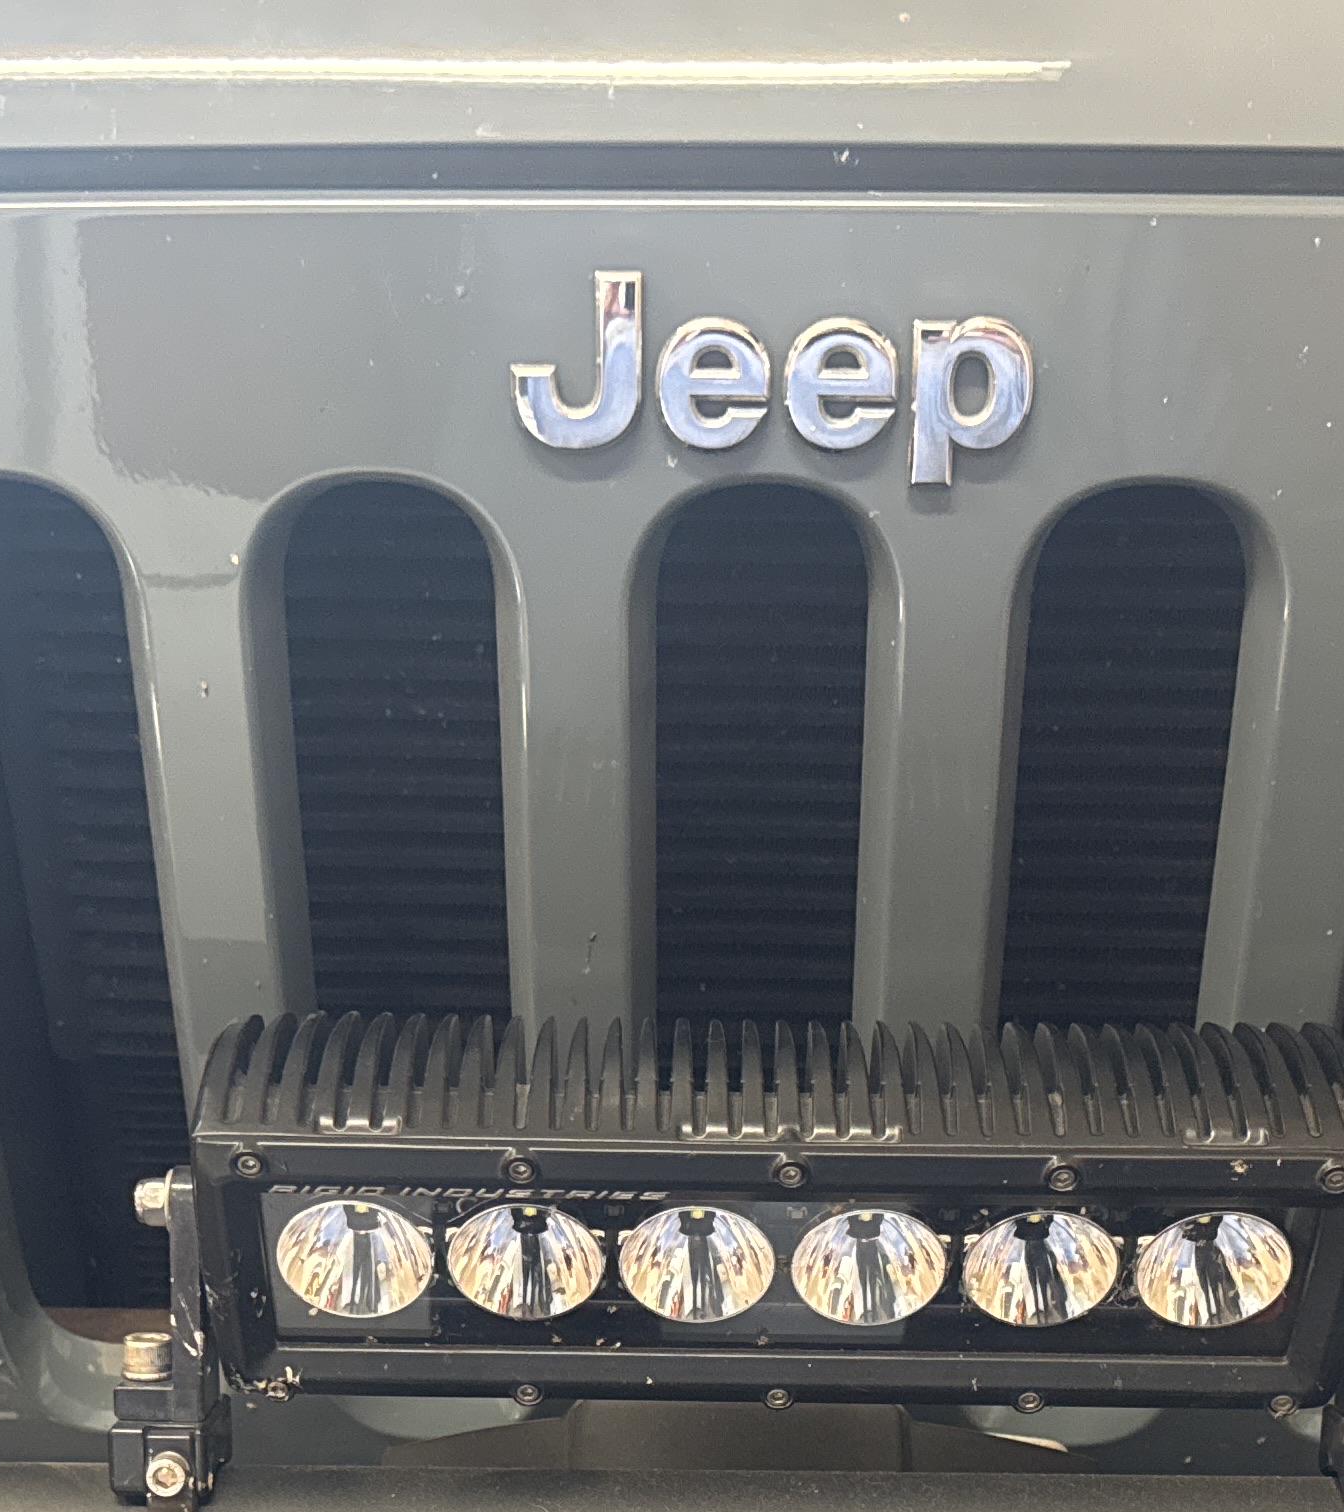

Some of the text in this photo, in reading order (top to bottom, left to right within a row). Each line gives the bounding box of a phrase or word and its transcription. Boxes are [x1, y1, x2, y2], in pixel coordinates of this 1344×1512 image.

[509, 269, 1034, 487] Jeep
[267, 1184, 672, 1201] RIGID INDUSTRIES
